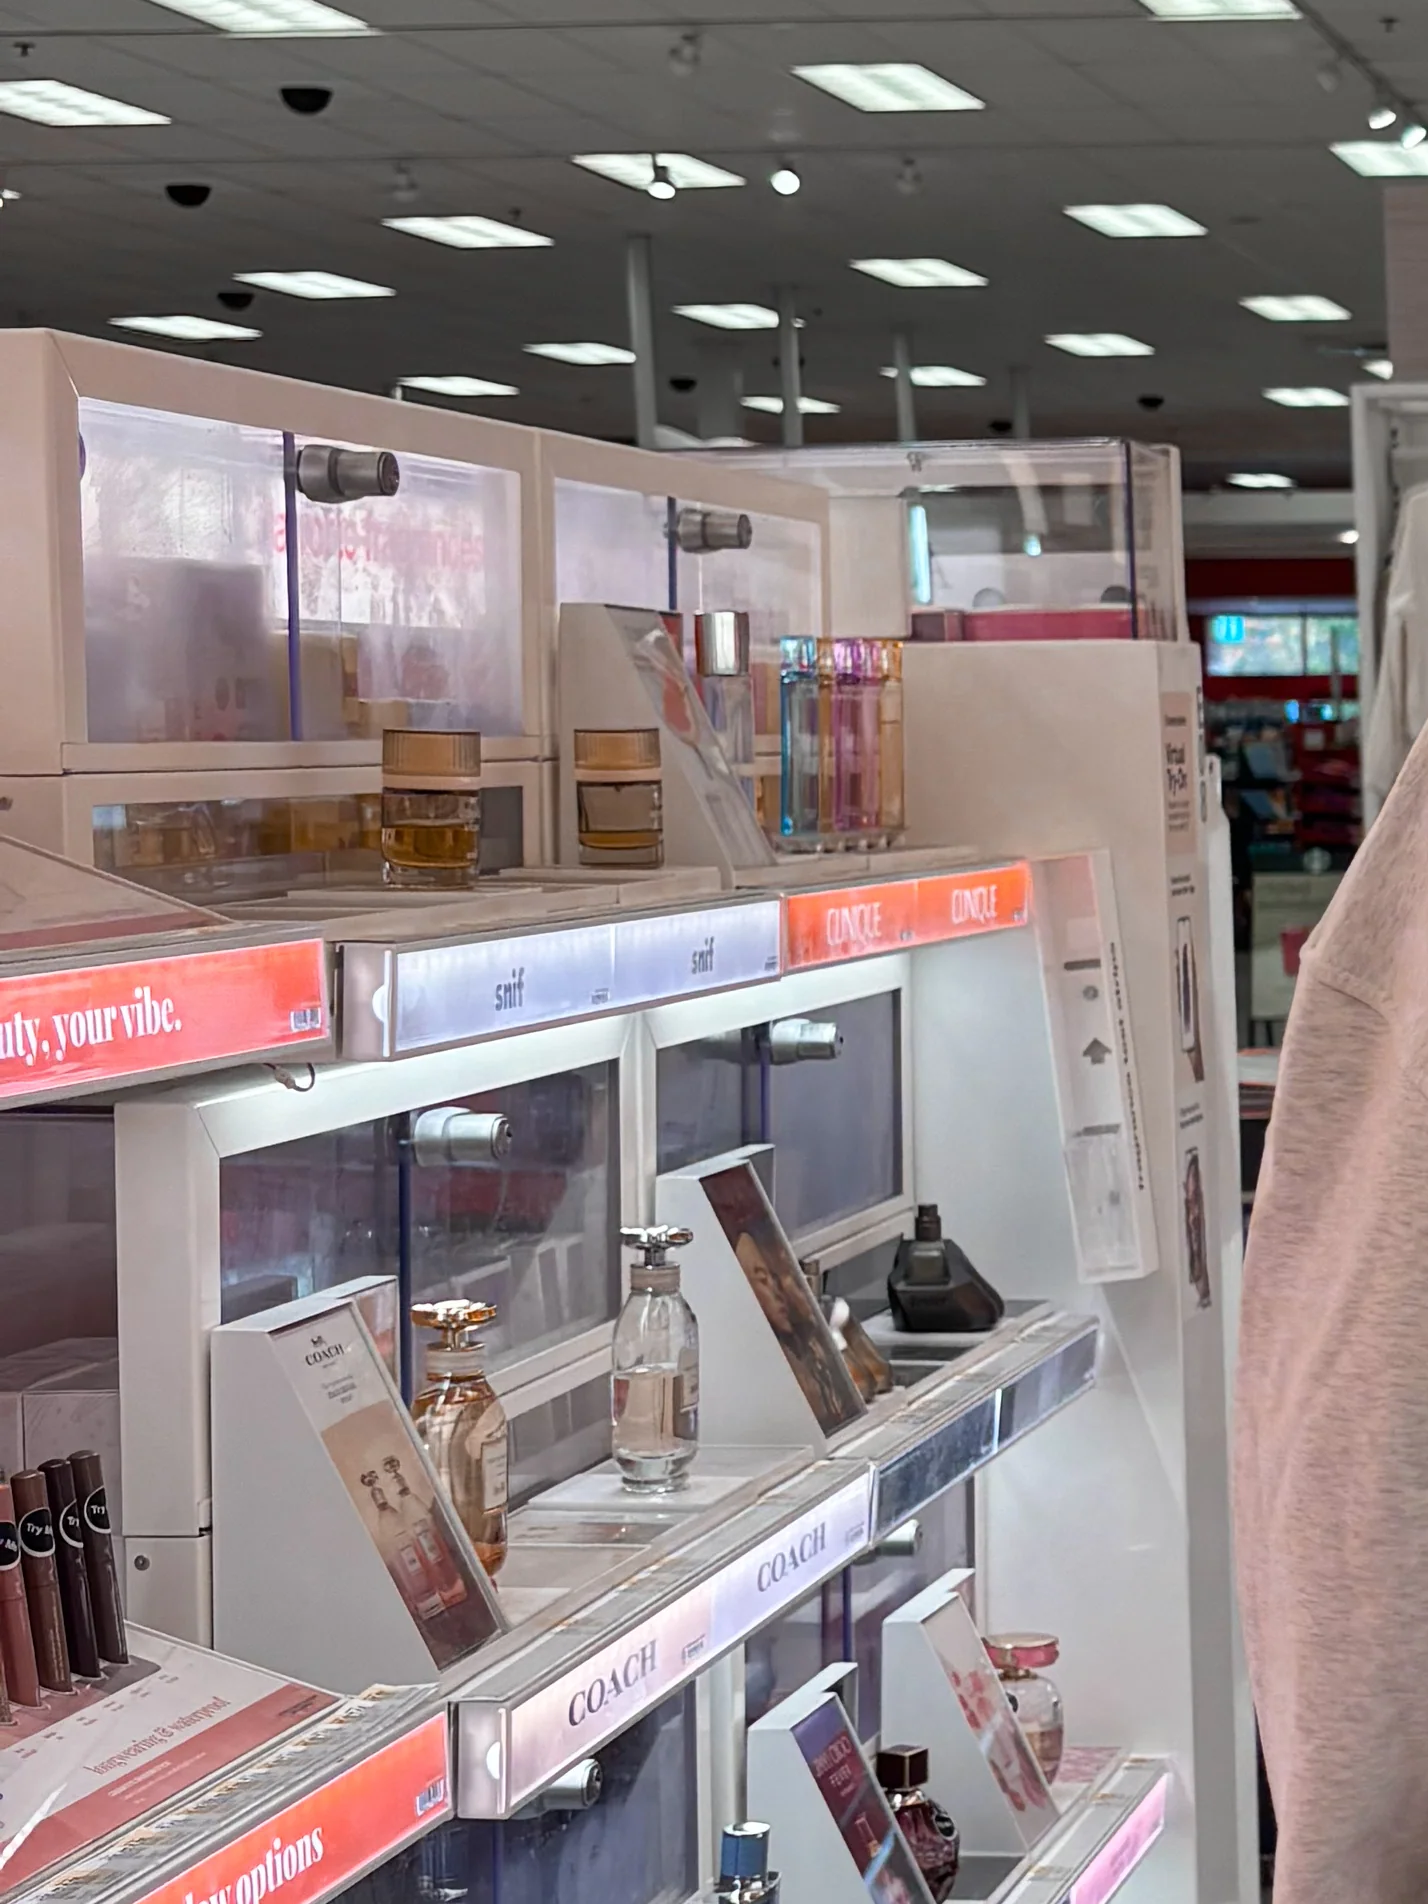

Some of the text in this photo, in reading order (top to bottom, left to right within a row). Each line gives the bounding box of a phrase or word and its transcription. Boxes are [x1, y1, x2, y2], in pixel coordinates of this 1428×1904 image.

[826, 901, 881, 946] CLINIQUE
[952, 884, 998, 924] CLINIQUE
[691, 936, 716, 973] snif
[494, 967, 525, 1011] snif
[52, 1006, 117, 1061] your
[120, 986, 182, 1038] vibe.
[305, 1344, 344, 1366] COACH
[26, 1522, 43, 1535] Try
[757, 1522, 827, 1592] COACH
[568, 1638, 657, 1727] COACH
